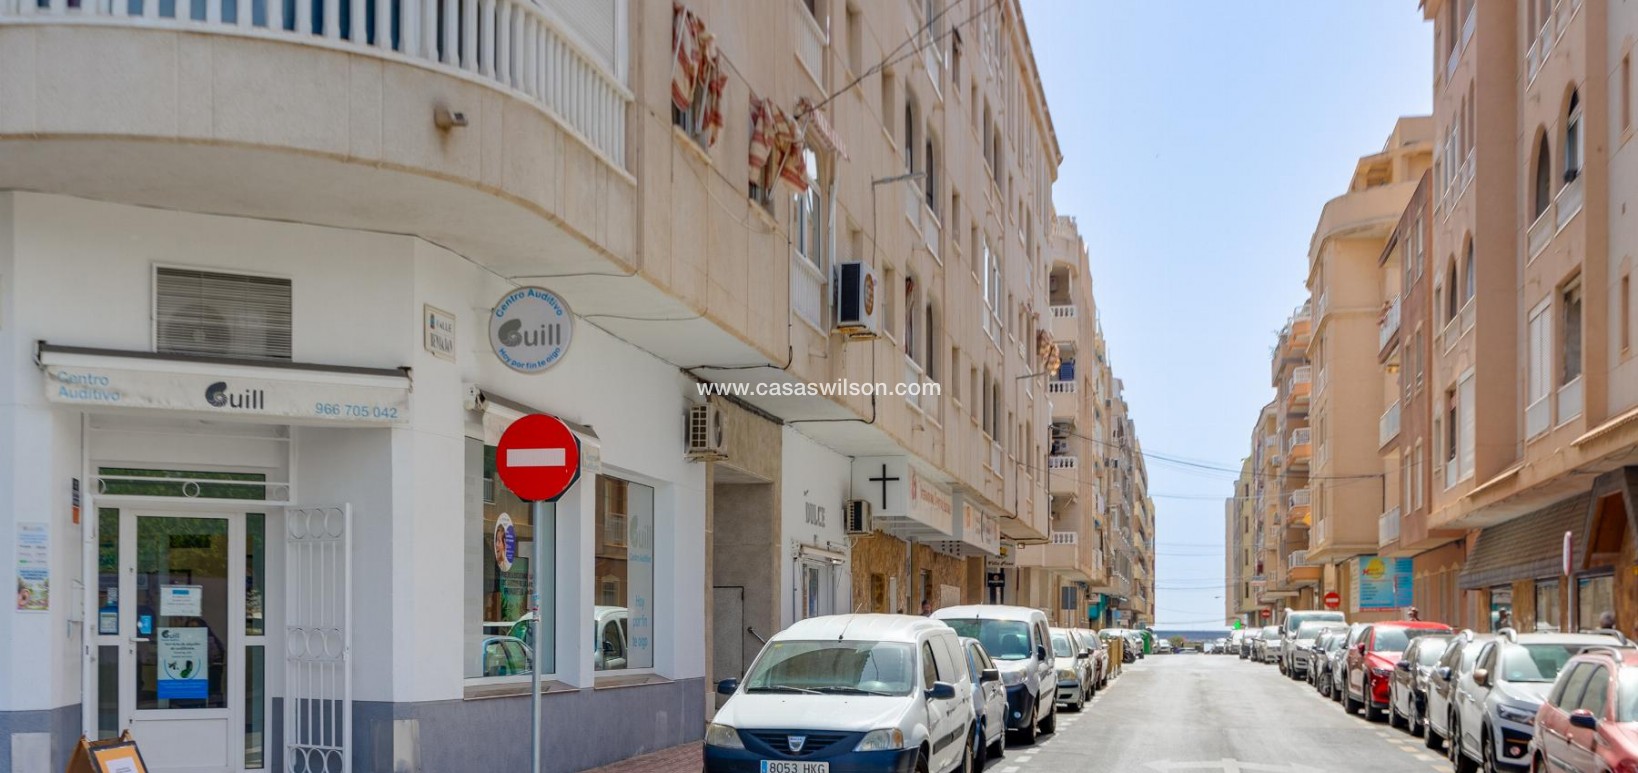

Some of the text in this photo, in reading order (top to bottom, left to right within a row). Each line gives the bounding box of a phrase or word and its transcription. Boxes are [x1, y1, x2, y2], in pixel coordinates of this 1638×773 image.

[495, 288, 563, 318] Centro Auditivo
[498, 318, 561, 347] Guill
[511, 360, 525, 369] por
[526, 360, 538, 369] fin
[537, 359, 547, 367] te
[546, 347, 561, 363] oigo
[58, 371, 109, 386] Centro
[59, 385, 120, 402] Auditivo
[205, 381, 264, 410] Guill
[315, 402, 398, 419] 966 705 042
[805, 501, 826, 528] DULCE
[769, 762, 825, 773] 8053 HKG
